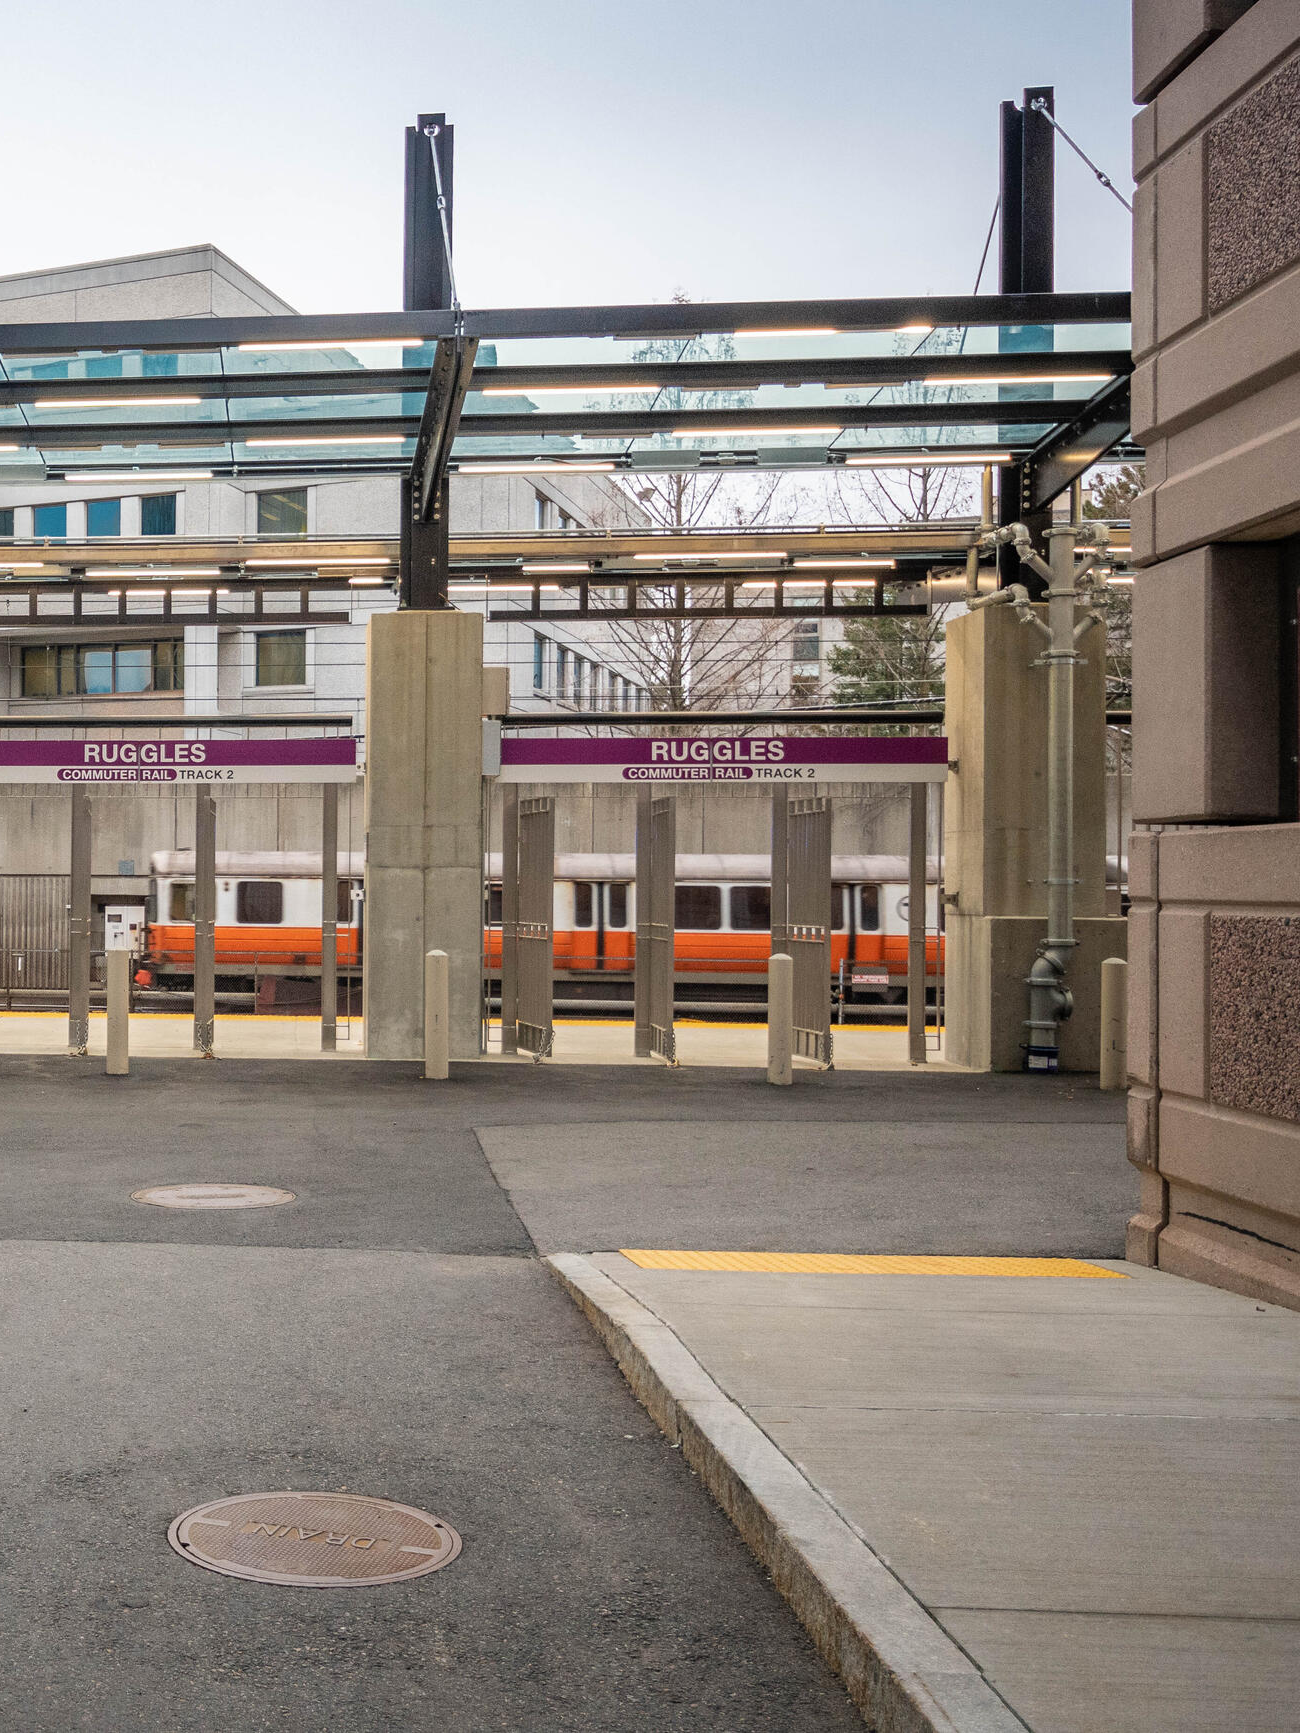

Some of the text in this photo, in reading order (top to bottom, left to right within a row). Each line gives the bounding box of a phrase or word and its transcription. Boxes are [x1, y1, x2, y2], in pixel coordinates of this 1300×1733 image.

[84, 743, 206, 763] RUGGLES
[651, 741, 785, 761] RUGGLES
[62, 769, 234, 780] COMMUTER RAIL TRACK 2
[628, 768, 815, 779] COMMUTER RAIL TRACK 2
[251, 1522, 378, 1549] DRAIN
